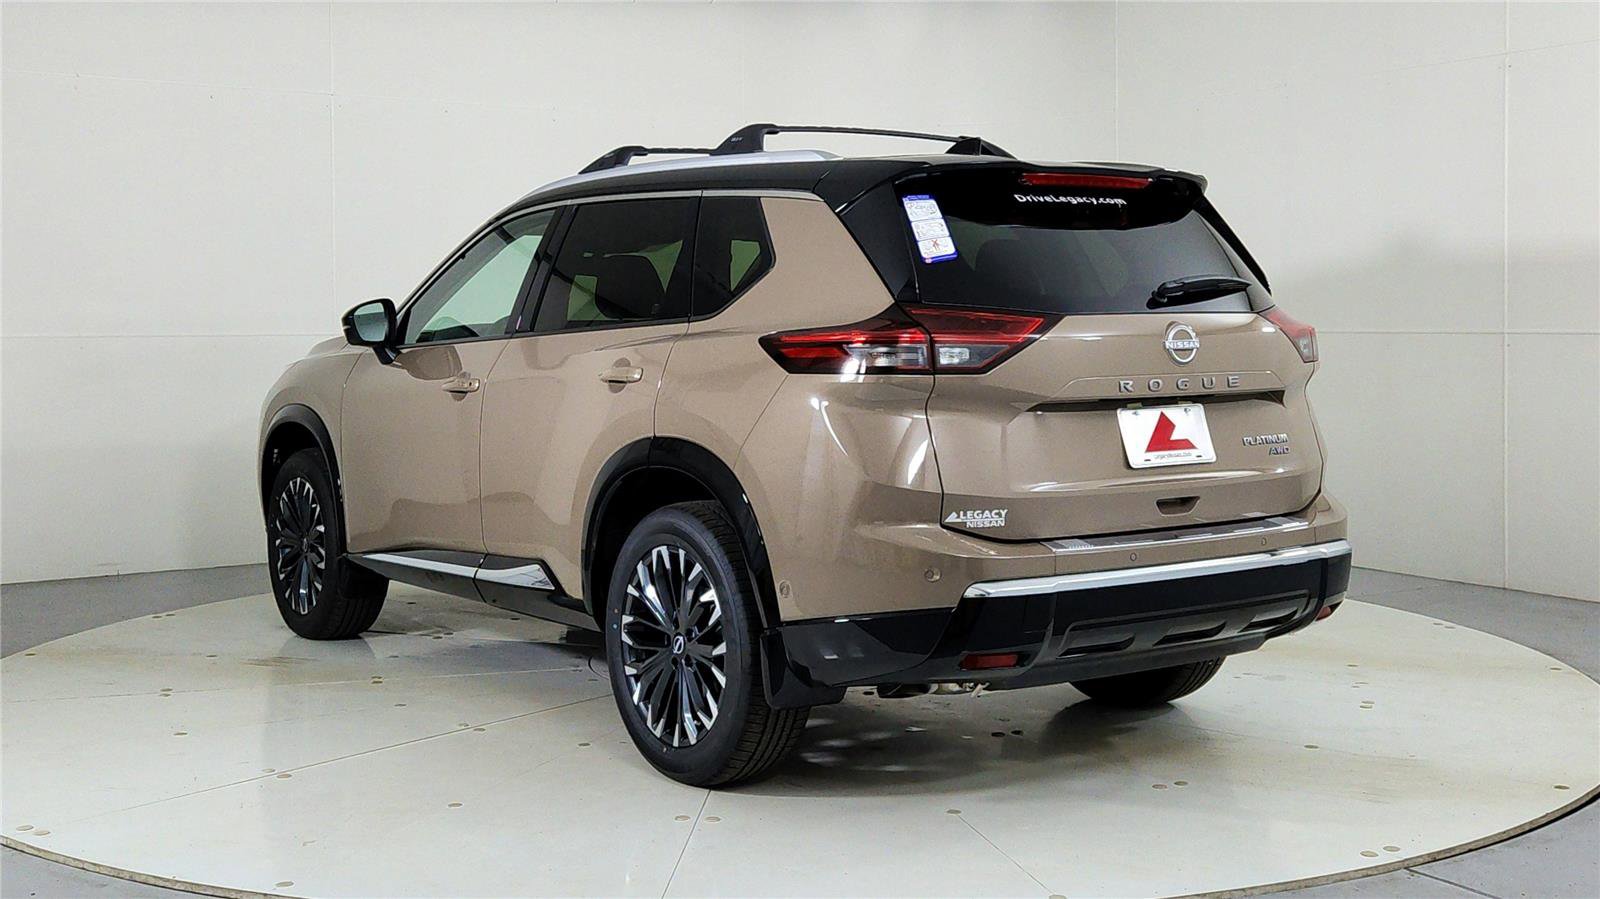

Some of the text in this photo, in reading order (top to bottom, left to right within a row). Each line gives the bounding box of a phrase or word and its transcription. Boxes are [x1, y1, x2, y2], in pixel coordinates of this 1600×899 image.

[1014, 194, 1127, 206] DriveLegacy.com
[1165, 340, 1199, 349] NISSAN
[1119, 376, 1240, 393] ROGUE
[1243, 433, 1289, 446] PLATINUM
[1269, 446, 1290, 456] AWD
[960, 509, 1008, 519] LEGACY
[966, 519, 1005, 528] NISSAN
